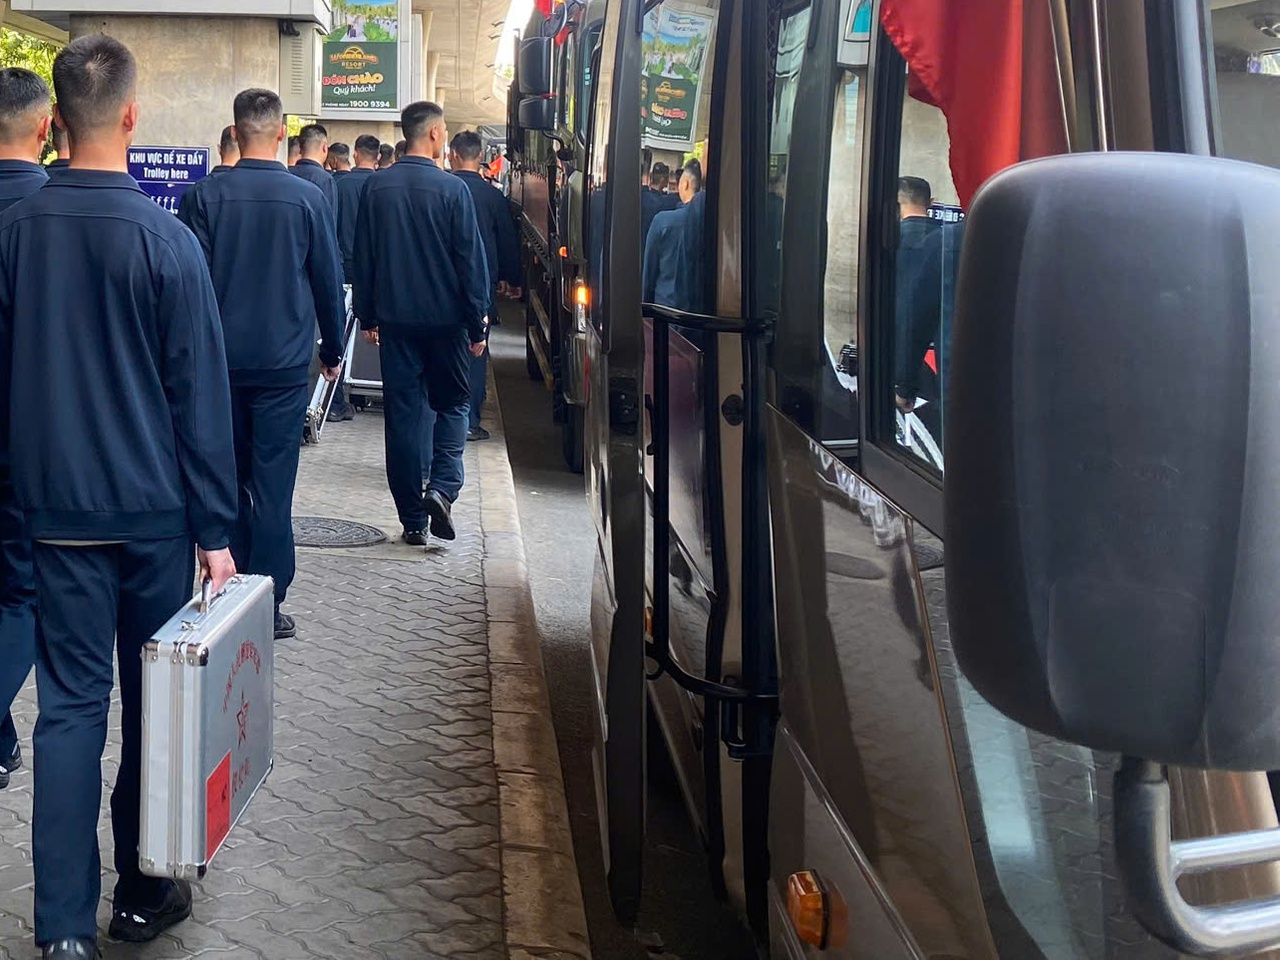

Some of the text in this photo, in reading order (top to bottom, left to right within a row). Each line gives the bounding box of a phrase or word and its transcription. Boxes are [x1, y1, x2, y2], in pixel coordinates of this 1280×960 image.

[322, 71, 384, 86] ĐÓN CHÀO
[333, 84, 376, 96] Quý khách!
[349, 100, 369, 108] 1900
[370, 100, 390, 108] 9394
[129, 152, 146, 164] KHU
[147, 151, 163, 166] VỰC
[175, 153, 186, 165] XE
[143, 167, 189, 180] Trolley here
